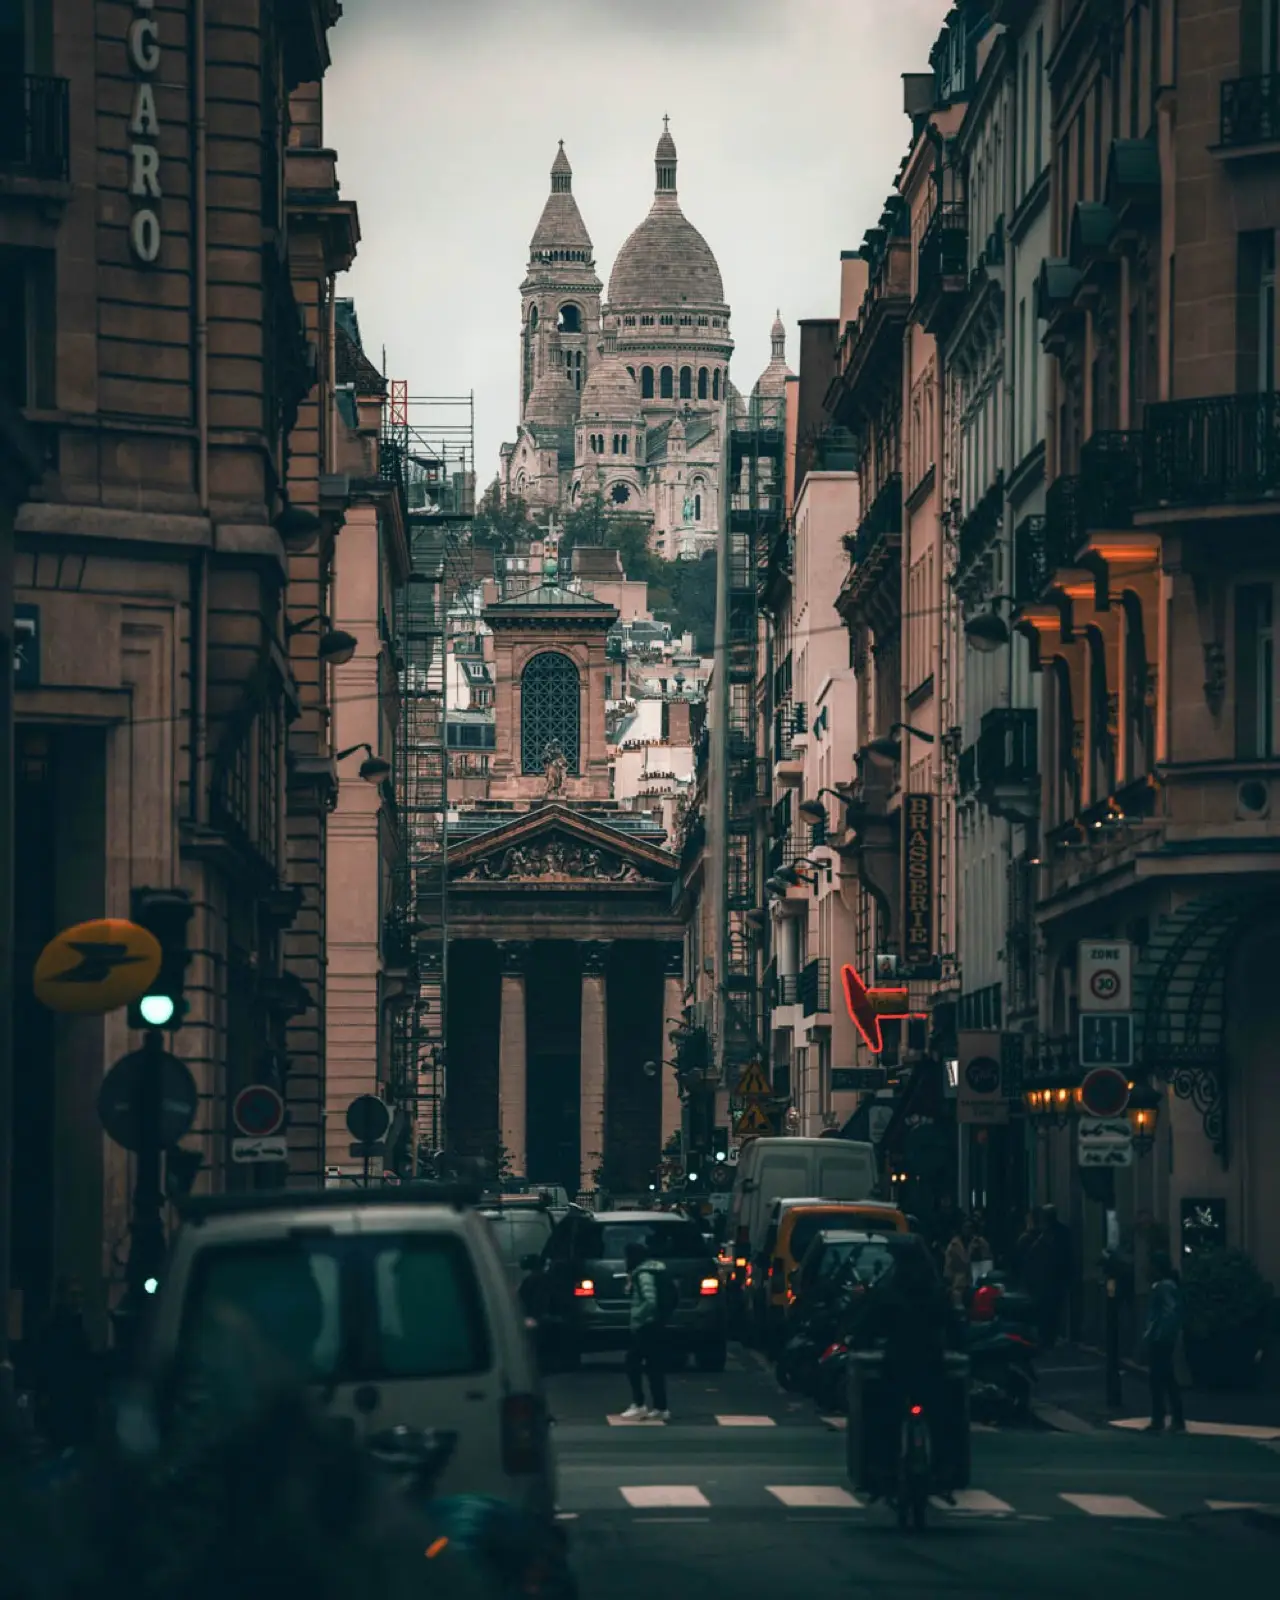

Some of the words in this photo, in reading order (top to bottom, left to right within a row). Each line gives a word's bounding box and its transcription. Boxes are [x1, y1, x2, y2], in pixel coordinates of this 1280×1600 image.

[129, 0, 161, 262] GARO
[909, 797, 929, 944] BRASSERIE
[1091, 949, 1120, 960] ZONE
[1098, 978, 1114, 991] 30
